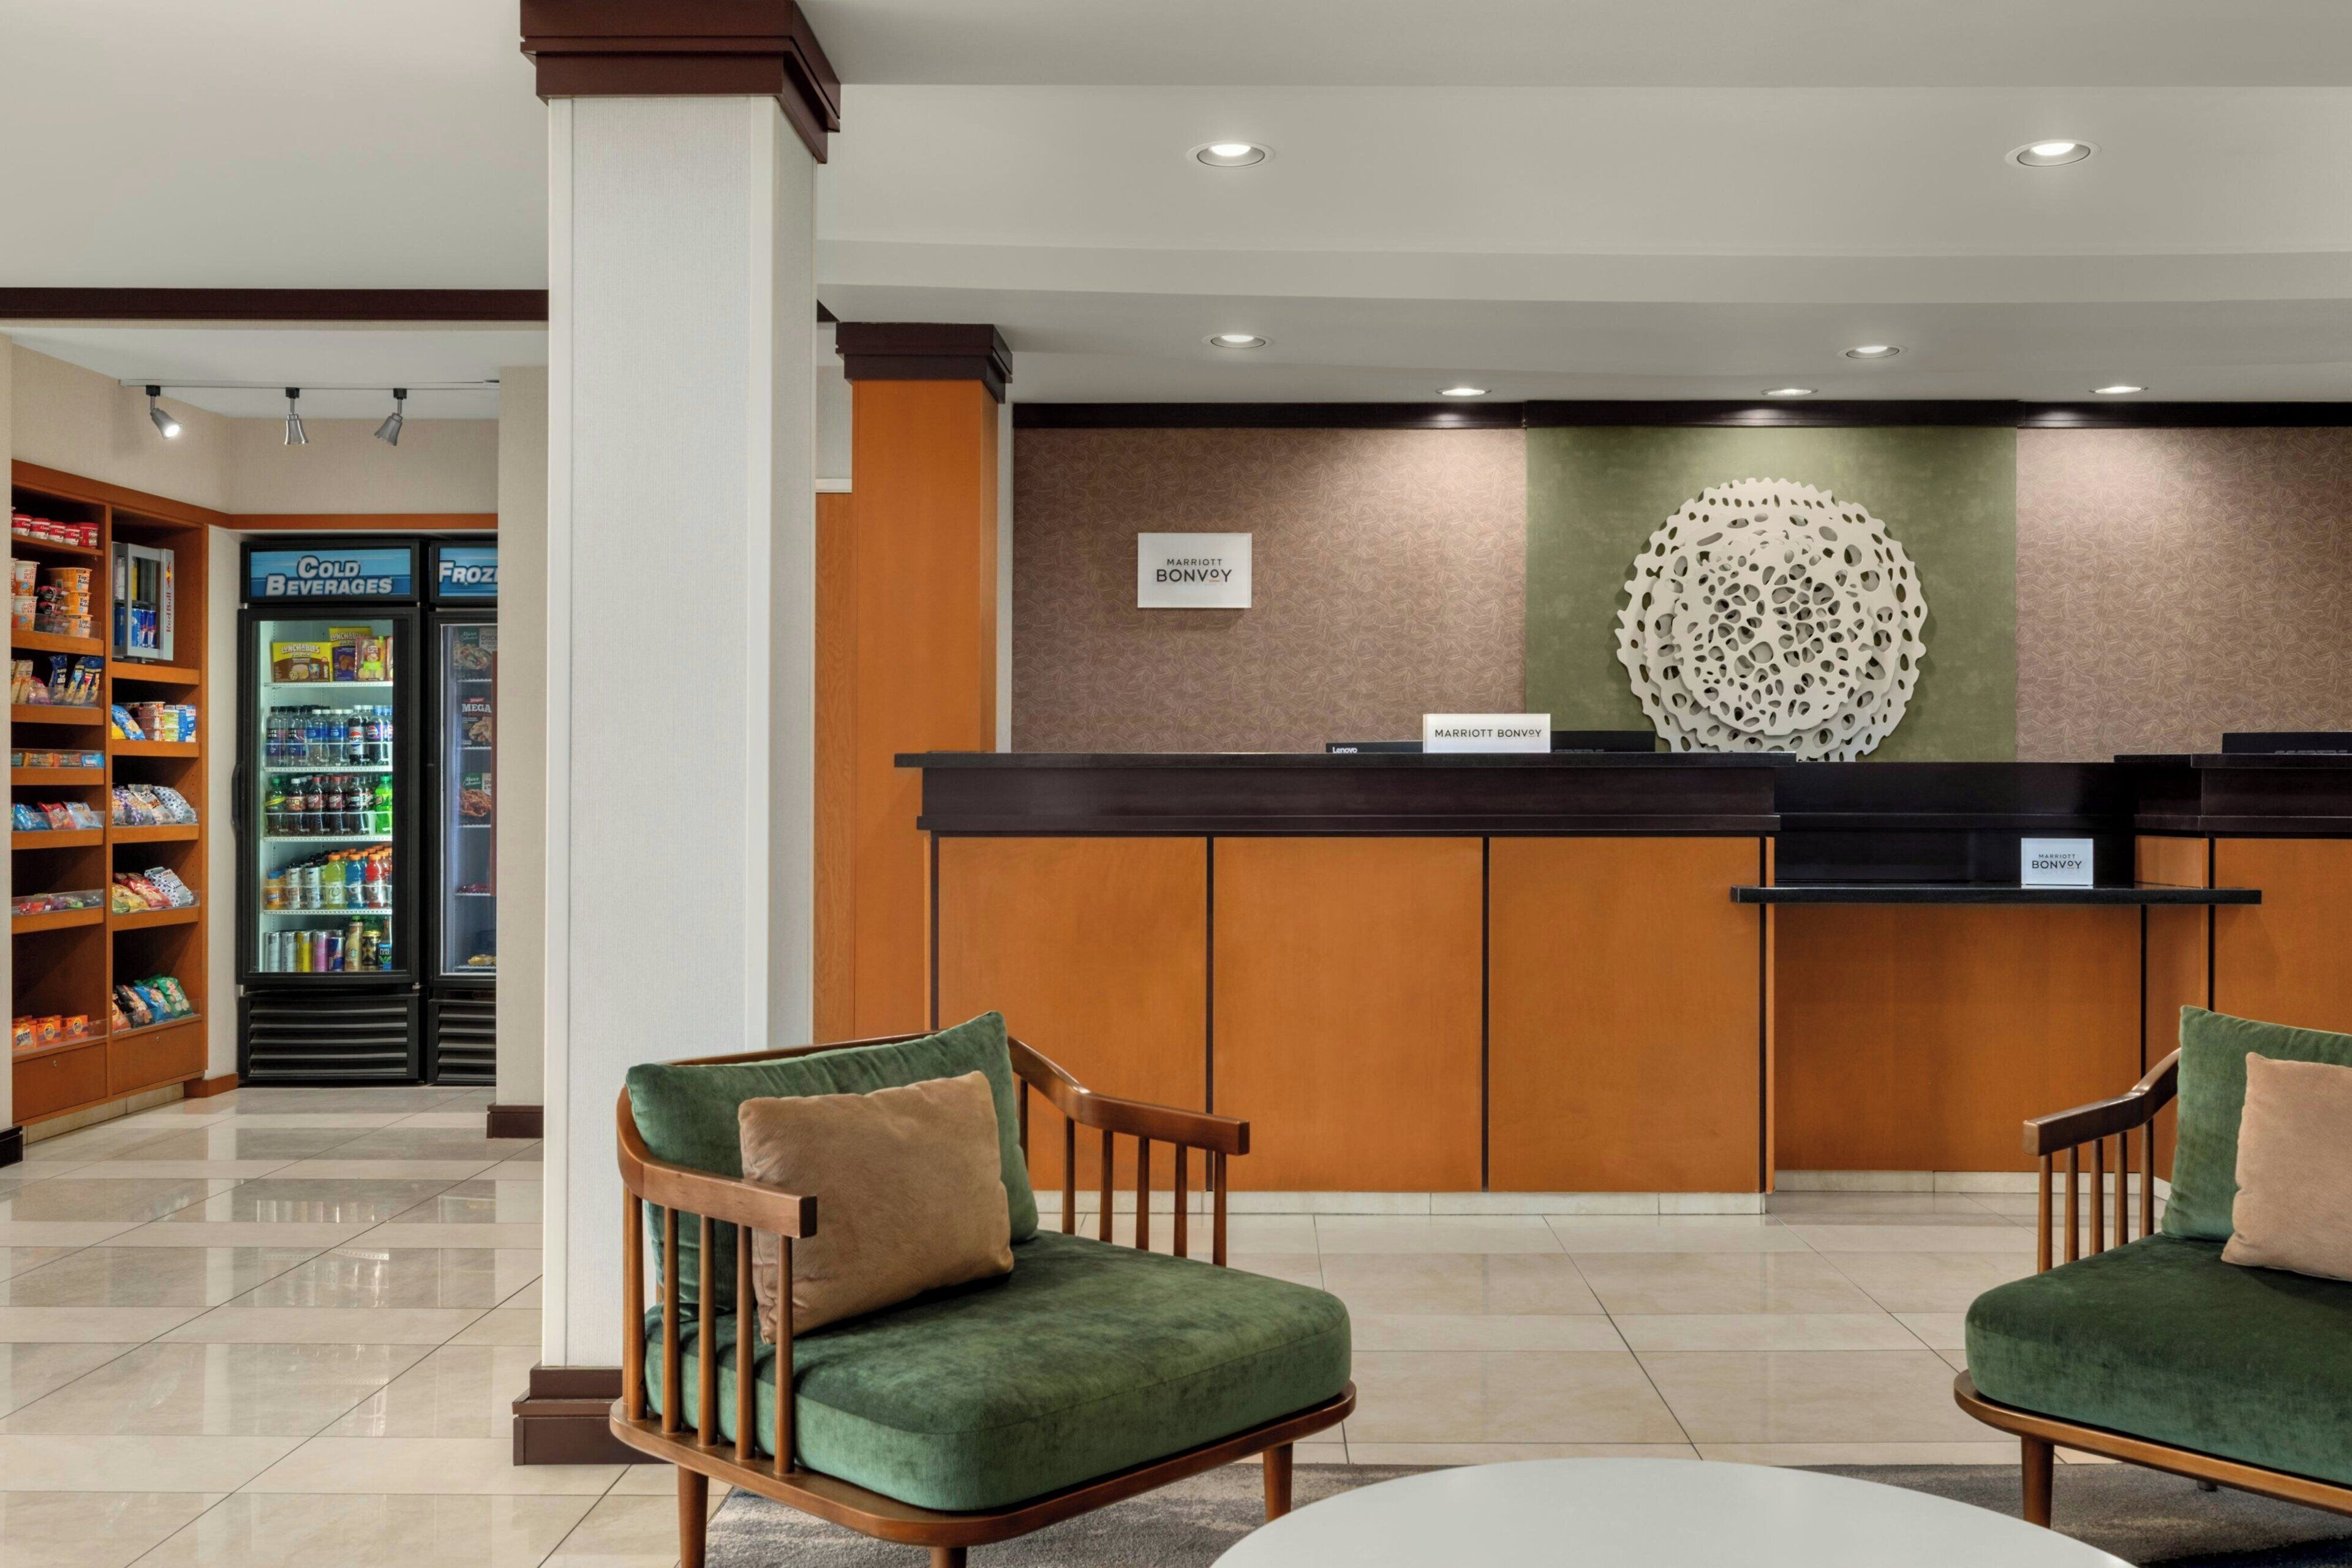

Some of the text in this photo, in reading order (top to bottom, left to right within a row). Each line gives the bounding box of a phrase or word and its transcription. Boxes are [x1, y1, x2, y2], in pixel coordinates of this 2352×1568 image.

[1156, 569, 1232, 582] BONVOY
[462, 704, 492, 713] MEGA
[1435, 729, 1542, 738] MARRIOTT BONVOY
[2032, 861, 2082, 869] BONVOY
